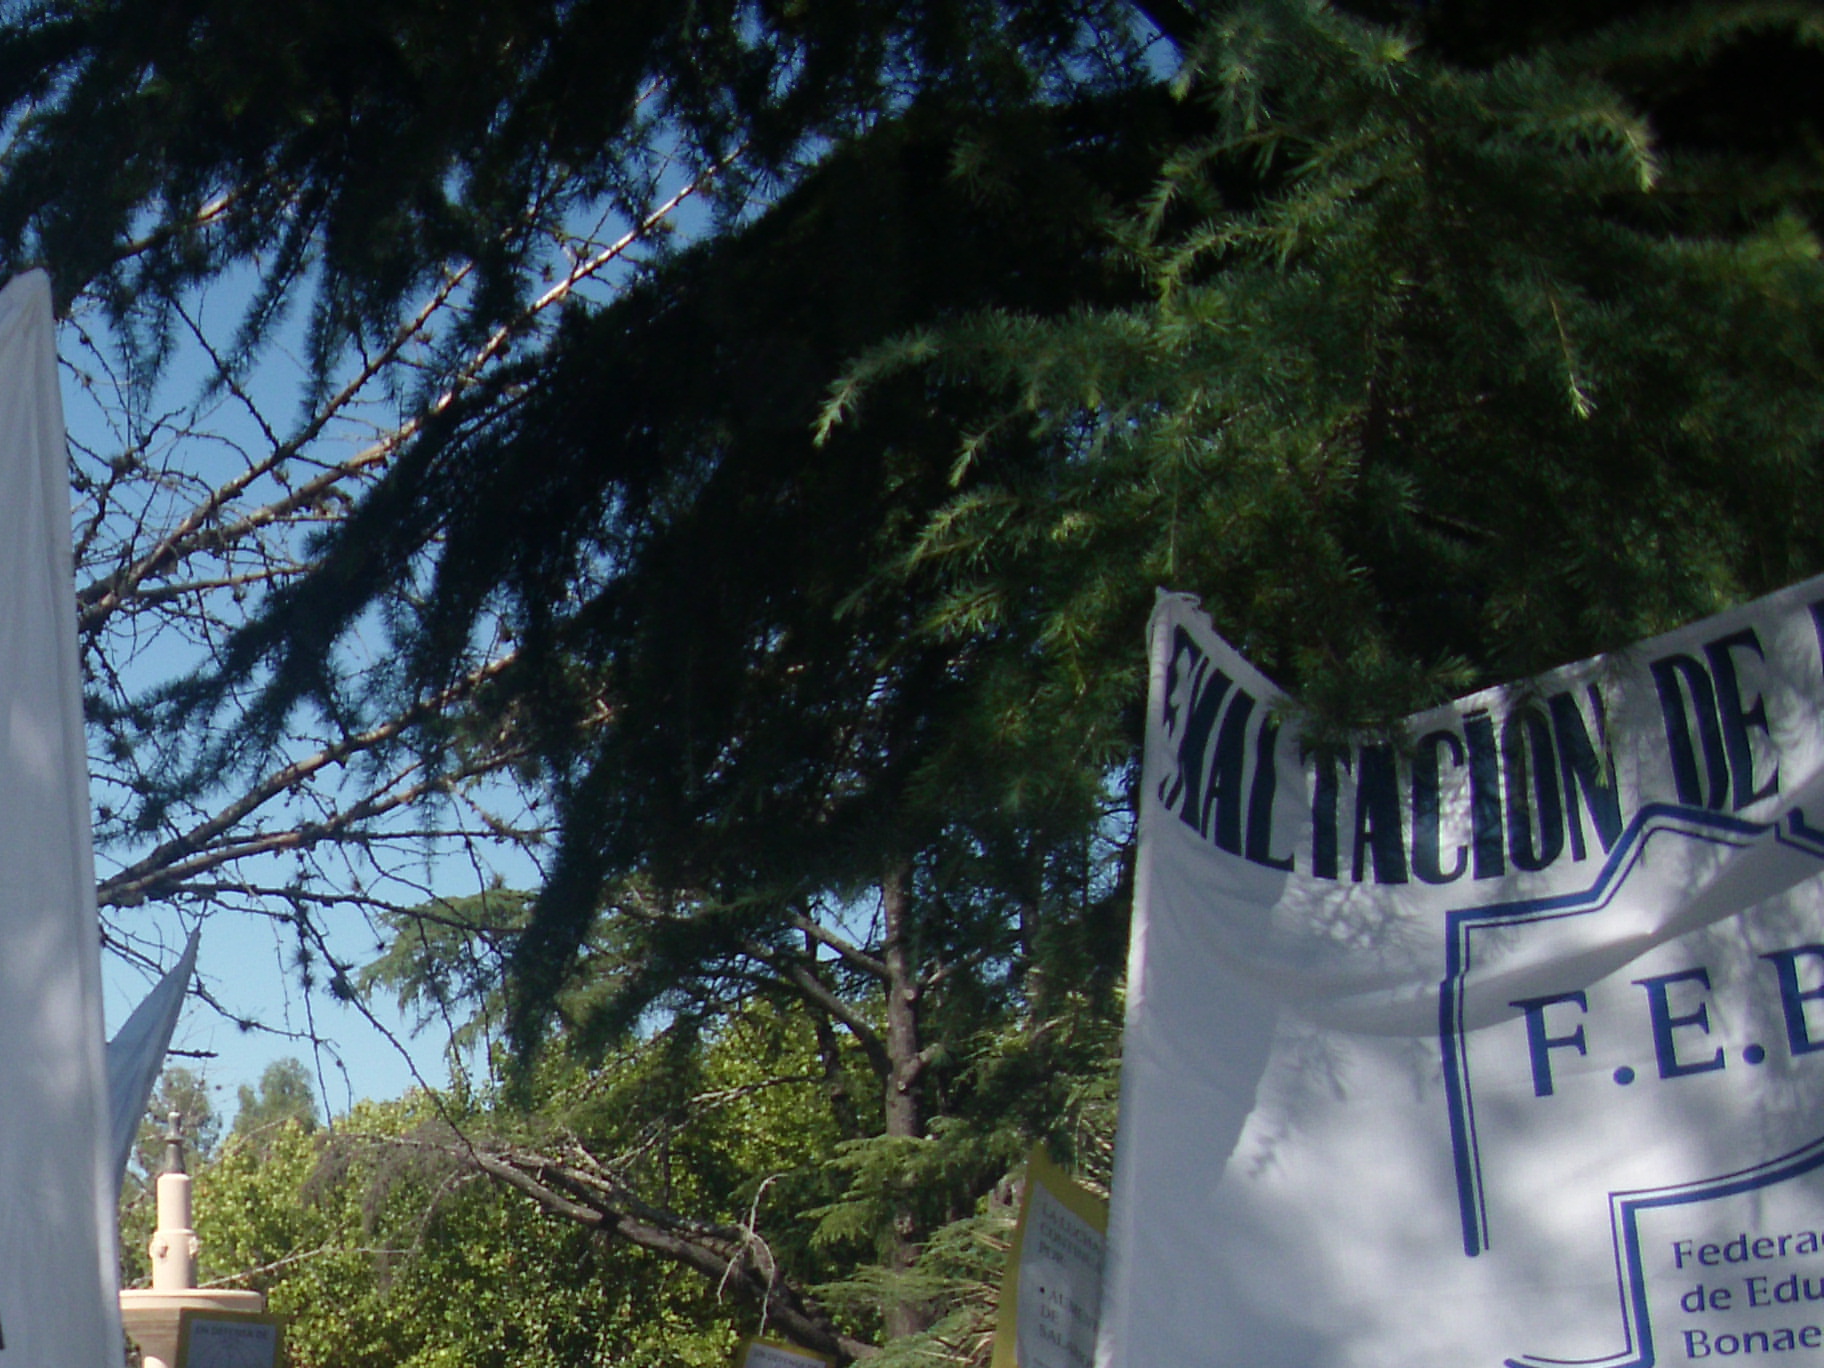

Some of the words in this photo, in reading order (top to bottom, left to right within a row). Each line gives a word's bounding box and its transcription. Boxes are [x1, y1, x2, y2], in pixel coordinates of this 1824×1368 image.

[1649, 627, 1778, 811] DE
[1671, 1230, 1824, 1270] Federa
[1680, 1283, 1733, 1313] de
